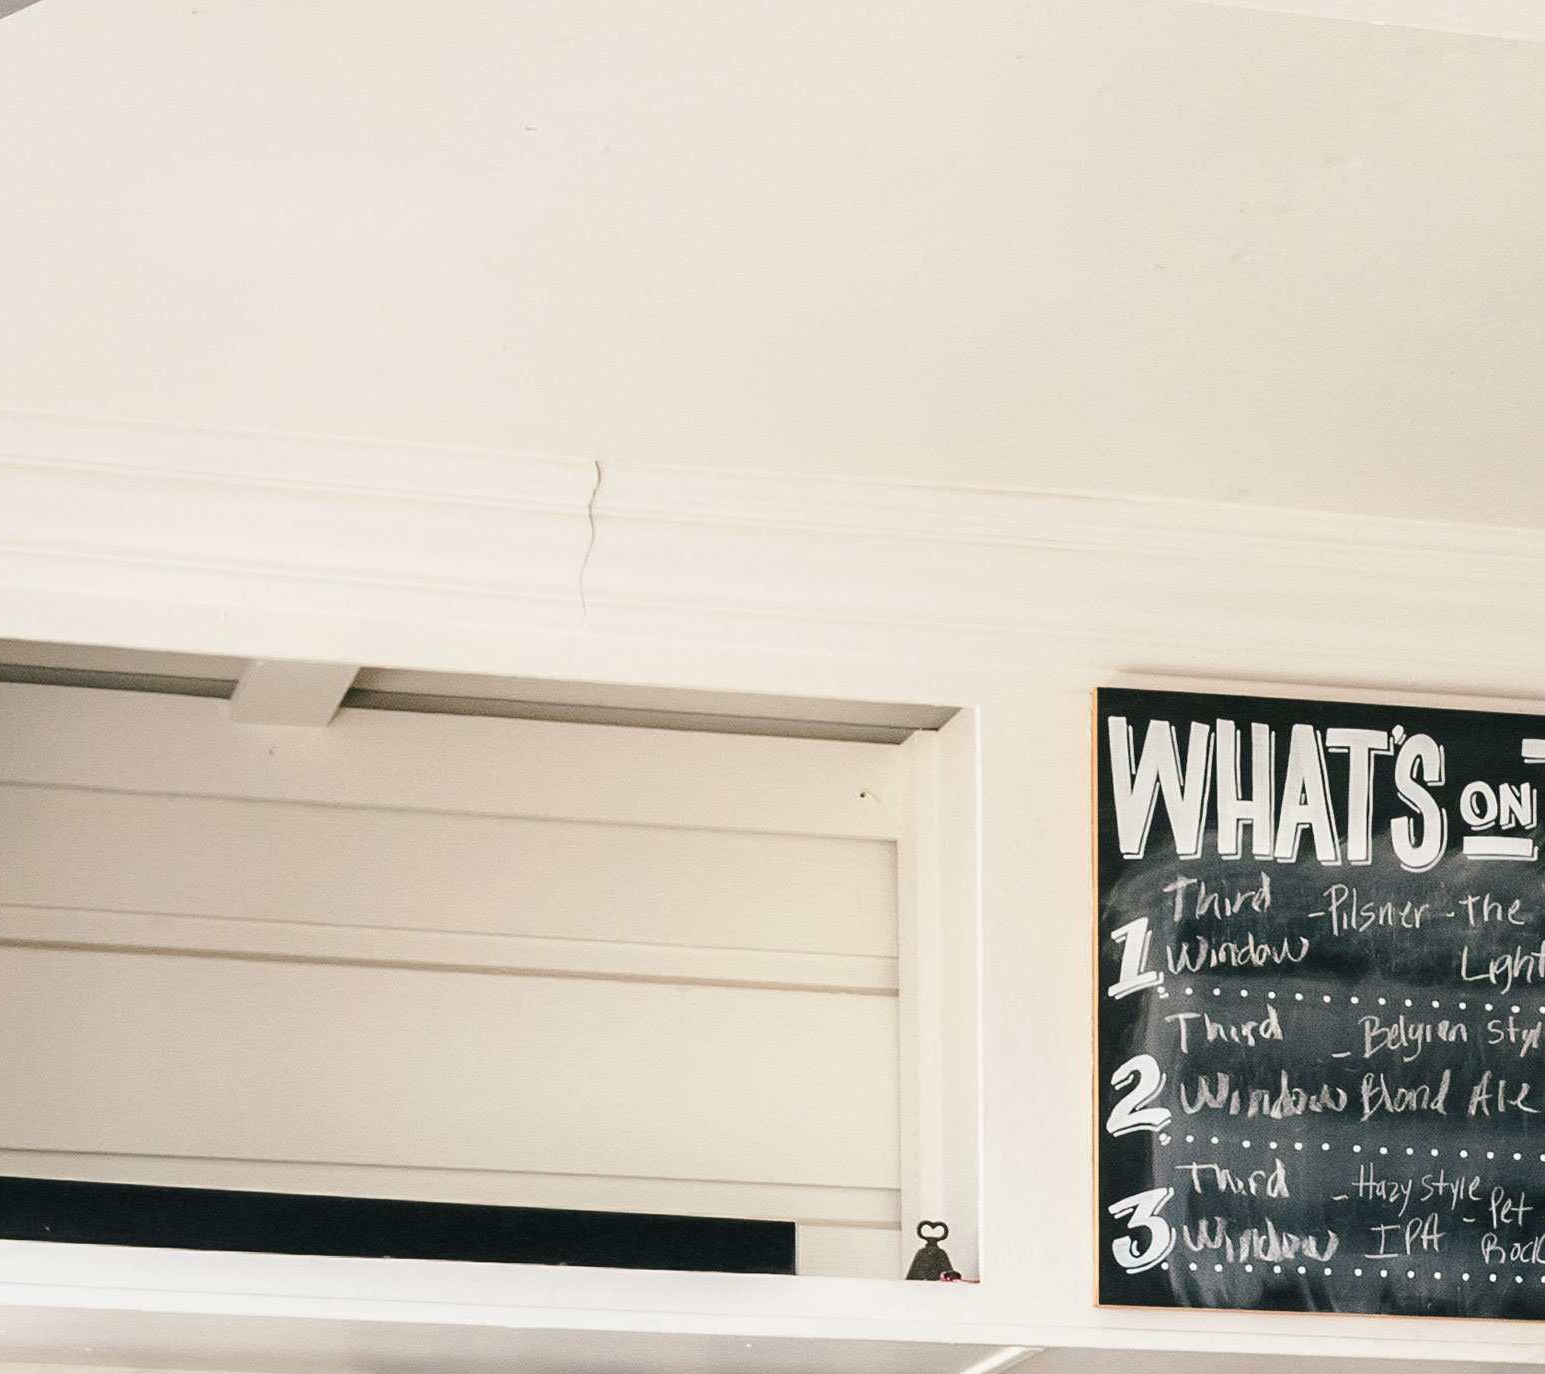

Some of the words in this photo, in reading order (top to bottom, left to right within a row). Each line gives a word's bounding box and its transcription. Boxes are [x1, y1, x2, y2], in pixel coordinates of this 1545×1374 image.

[1108, 717, 1447, 872] WHAT'S
[1460, 781, 1536, 830] ON
[1164, 872, 1271, 921] Third
[1108, 917, 1163, 999] 1
[1165, 935, 1309, 976] Window
[1165, 1006, 1284, 1054] Third
[1359, 1016, 1468, 1062] Belgian
[1107, 1054, 1172, 1136] 2
[1180, 1070, 1348, 1120] Window
[1360, 1070, 1451, 1121] Blond
[1468, 1071, 1543, 1117] Ale
[1176, 1159, 1290, 1198] Third
[1352, 1164, 1412, 1216] Hazy
[1108, 1187, 1176, 1274] 3
[1182, 1216, 1338, 1262] Window
[1365, 1219, 1448, 1259] IPA
